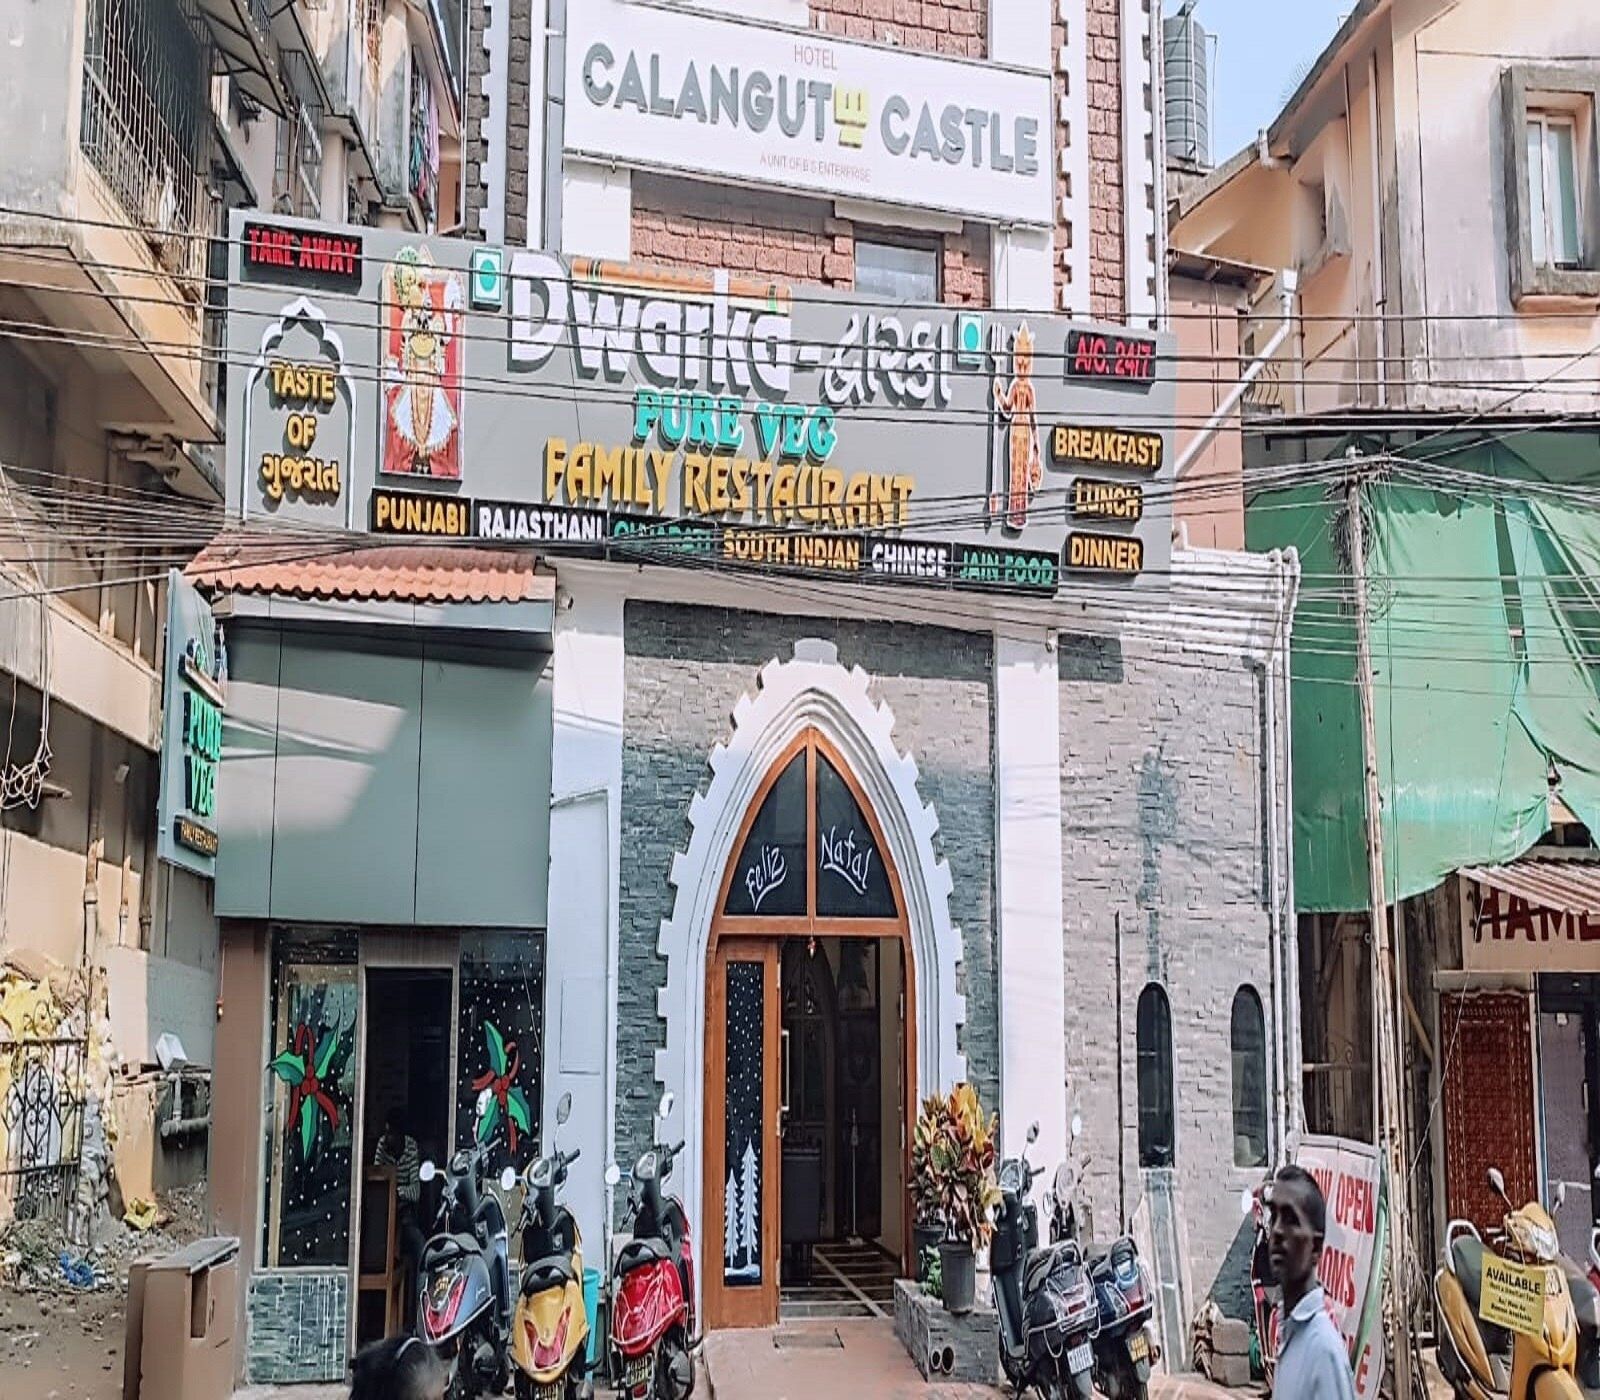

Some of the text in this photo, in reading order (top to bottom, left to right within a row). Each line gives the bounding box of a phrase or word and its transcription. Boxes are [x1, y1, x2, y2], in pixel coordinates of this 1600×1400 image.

[794, 44, 838, 71] HOTEL
[880, 95, 1039, 176] CASTLE
[768, 154, 787, 169] UNIT
[789, 157, 801, 171] OF
[248, 227, 358, 273] TAKE AWAY
[1115, 340, 1152, 379] 24/7
[269, 361, 336, 399] TASTE
[286, 413, 316, 448] OF
[634, 386, 837, 462] PURE VEG
[1054, 427, 1161, 466] BREAKFAST
[261, 455, 340, 498] ગુજરાત
[546, 437, 914, 528] FAMILY RESTAURANT
[376, 495, 466, 536] PUNJABI
[1076, 482, 1139, 518] LUNCH
[479, 507, 603, 541] RAJASTHANI
[723, 528, 860, 570] SOUTH INDIAN
[872, 543, 947, 578] CHINESE
[959, 549, 1054, 587] JAIN FOOD
[1071, 536, 1140, 570] DINNER
[190, 756, 215, 818] VEG
[745, 825, 872, 909] Feliz Natal
[1335, 1171, 1374, 1234] OPEN
[1486, 1266, 1541, 1296] AVAILABLE
